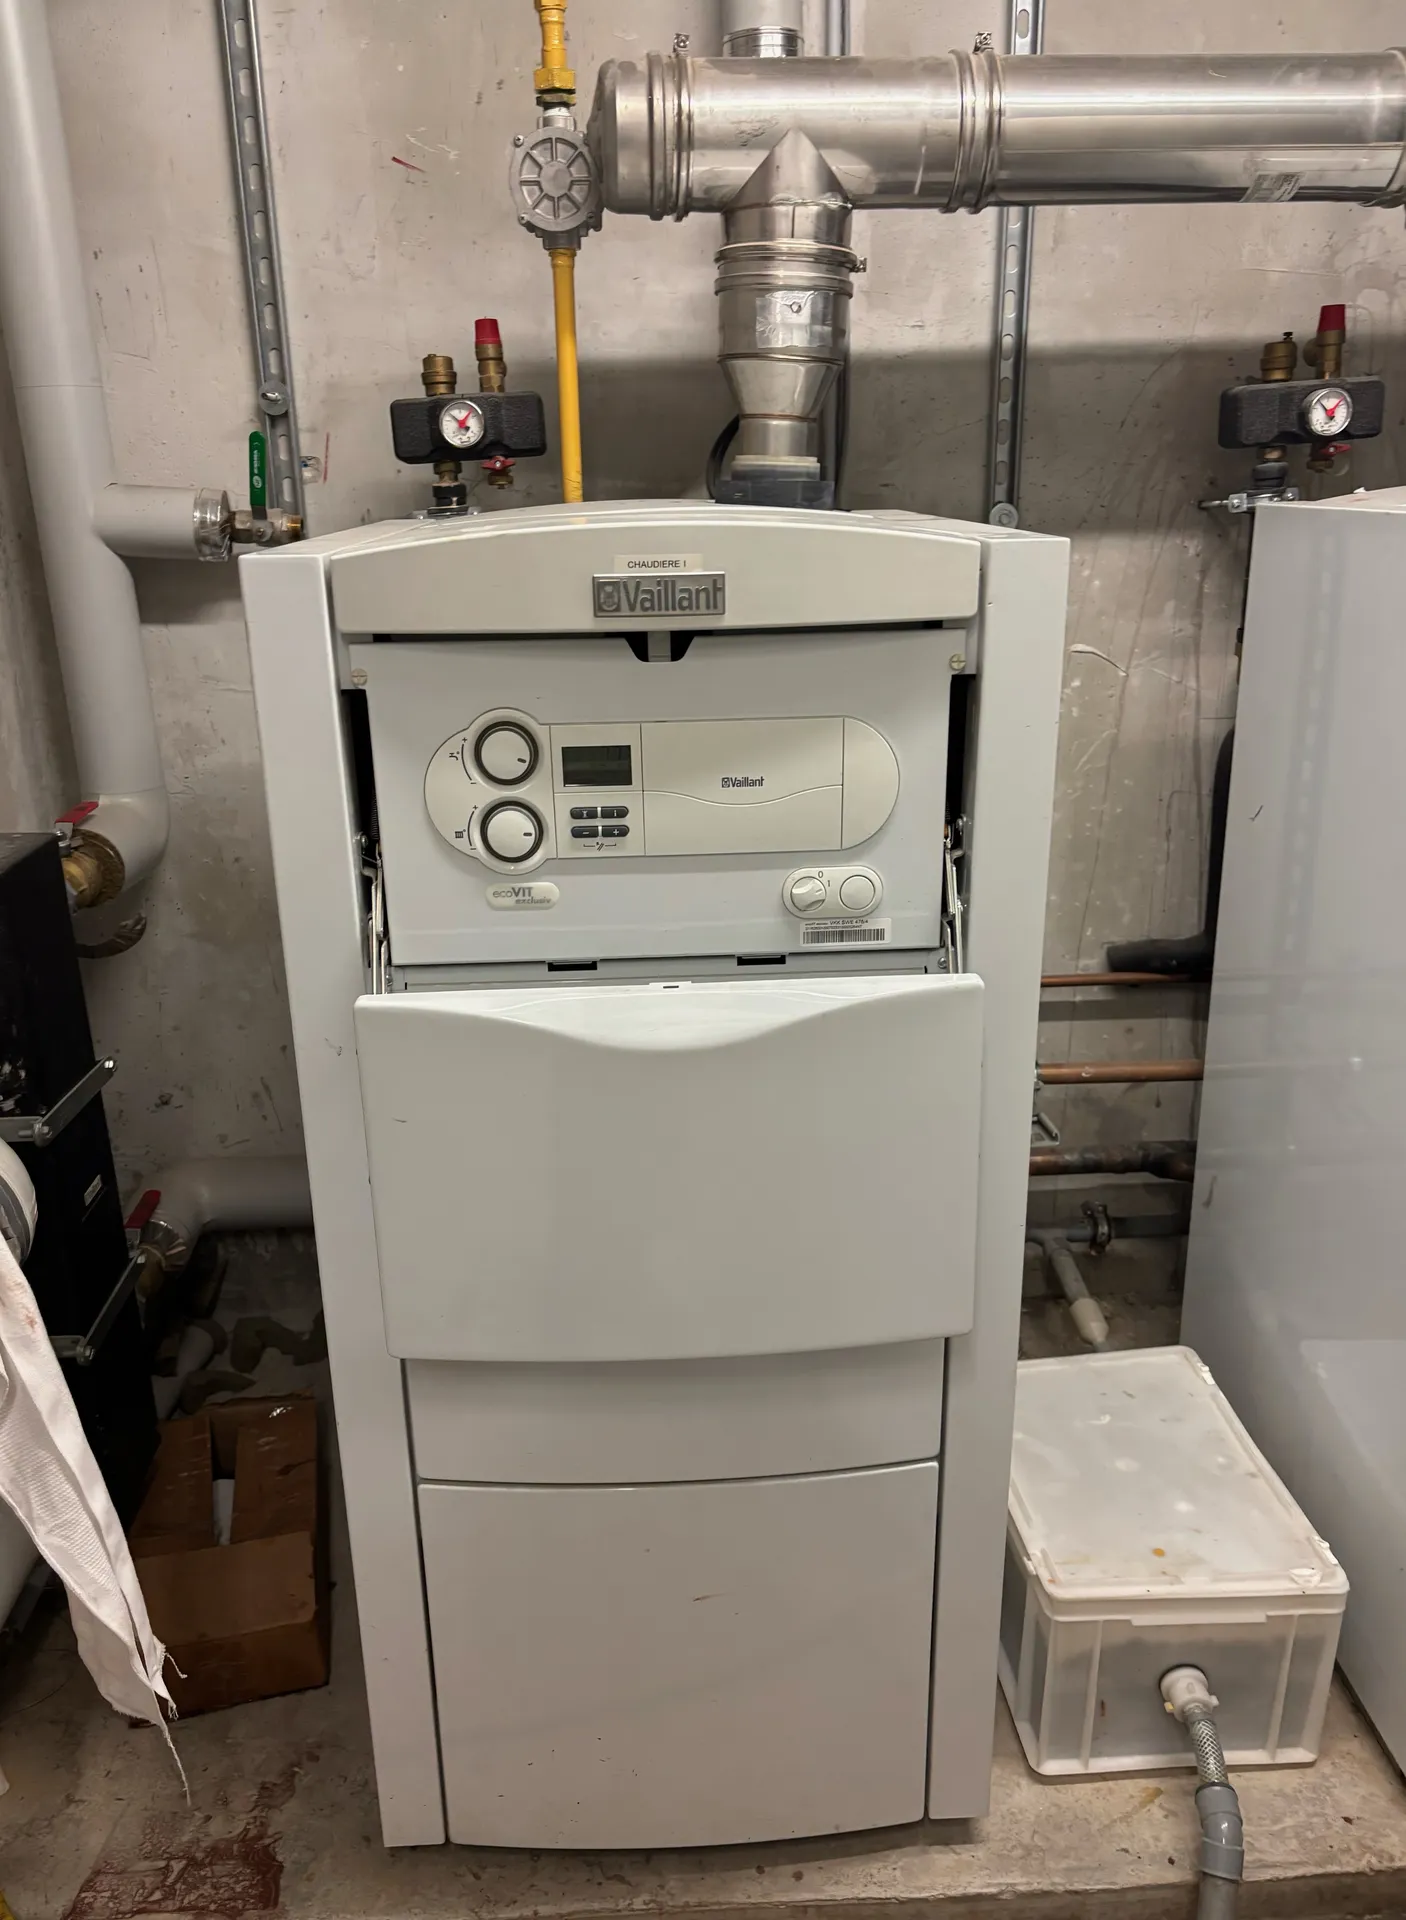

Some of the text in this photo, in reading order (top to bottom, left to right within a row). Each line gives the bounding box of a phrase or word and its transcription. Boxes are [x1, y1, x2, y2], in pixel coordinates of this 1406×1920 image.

[627, 559, 681, 569] CHAUDIERE
[621, 578, 723, 612] Vaillant
[730, 776, 765, 788] Vaillant
[492, 886, 534, 898] ecoVIT
[515, 896, 552, 905] exclusiv
